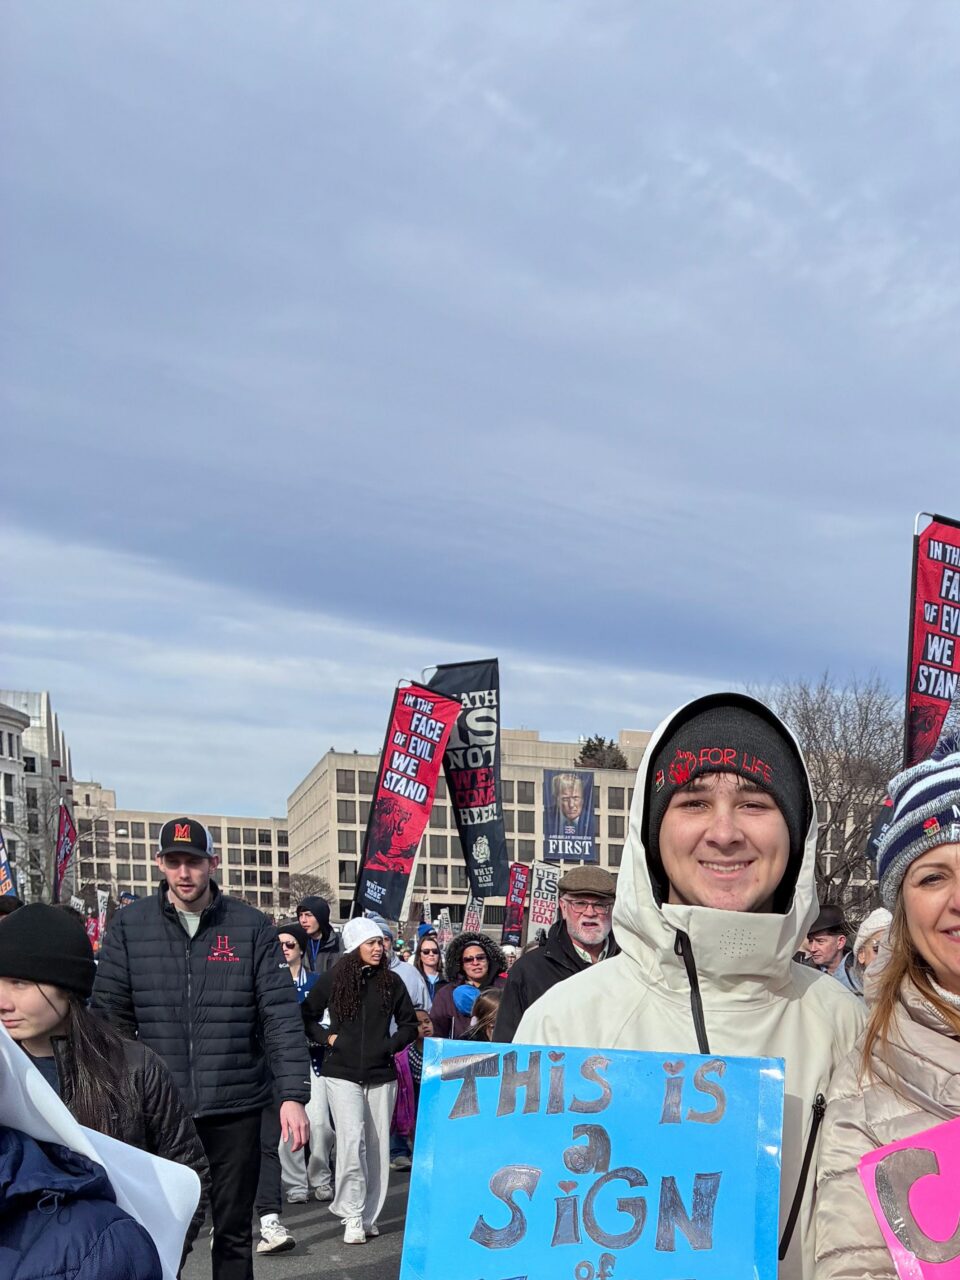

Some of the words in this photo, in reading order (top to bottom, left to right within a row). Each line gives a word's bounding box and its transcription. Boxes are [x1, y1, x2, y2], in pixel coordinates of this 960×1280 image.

[929, 540, 942, 561] IN
[924, 602, 938, 623] OF
[927, 633, 954, 665] WE
[917, 665, 959, 699] STAN
[404, 693, 414, 707] IN
[416, 697, 434, 714] THE
[460, 690, 498, 710] ATH
[410, 712, 445, 742] FACE
[394, 732, 407, 746] OF
[408, 735, 433, 763] EVIL,
[447, 745, 496, 770] NOT
[391, 751, 419, 777] WE
[699, 748, 737, 767] FOR
[742, 752, 773, 784] LIFE
[383, 771, 427, 803] STAND
[174, 823, 191, 842] M
[548, 839, 592, 855] FIRST
[536, 868, 558, 880] LIFE
[533, 890, 556, 901] OUR
[535, 877, 557, 894] IS
[532, 906, 555, 917] LUT
[532, 914, 552, 925] ION
[217, 935, 229, 949] H
[563, 1124, 612, 1175] a
